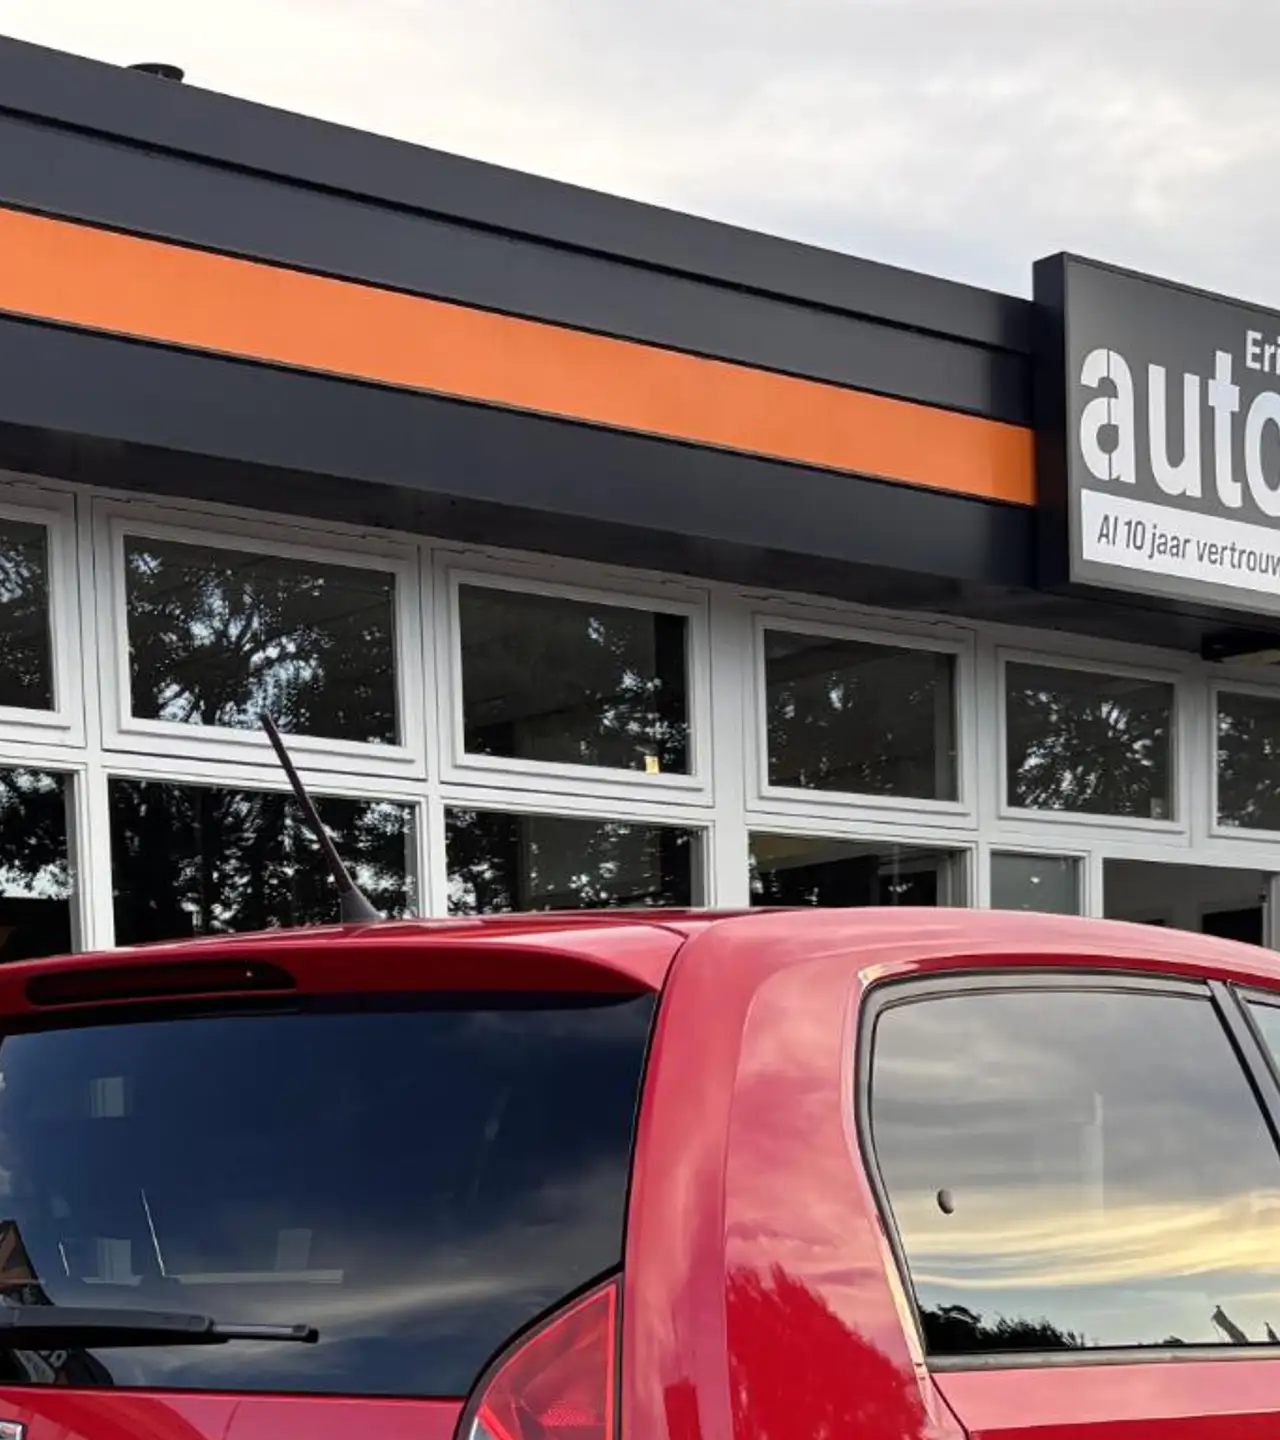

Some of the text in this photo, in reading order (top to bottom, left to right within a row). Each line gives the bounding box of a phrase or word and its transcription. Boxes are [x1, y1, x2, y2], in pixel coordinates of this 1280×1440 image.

[1097, 514, 1118, 546] Al
[1124, 519, 1146, 551] 10
[1148, 524, 1191, 560] jaar
